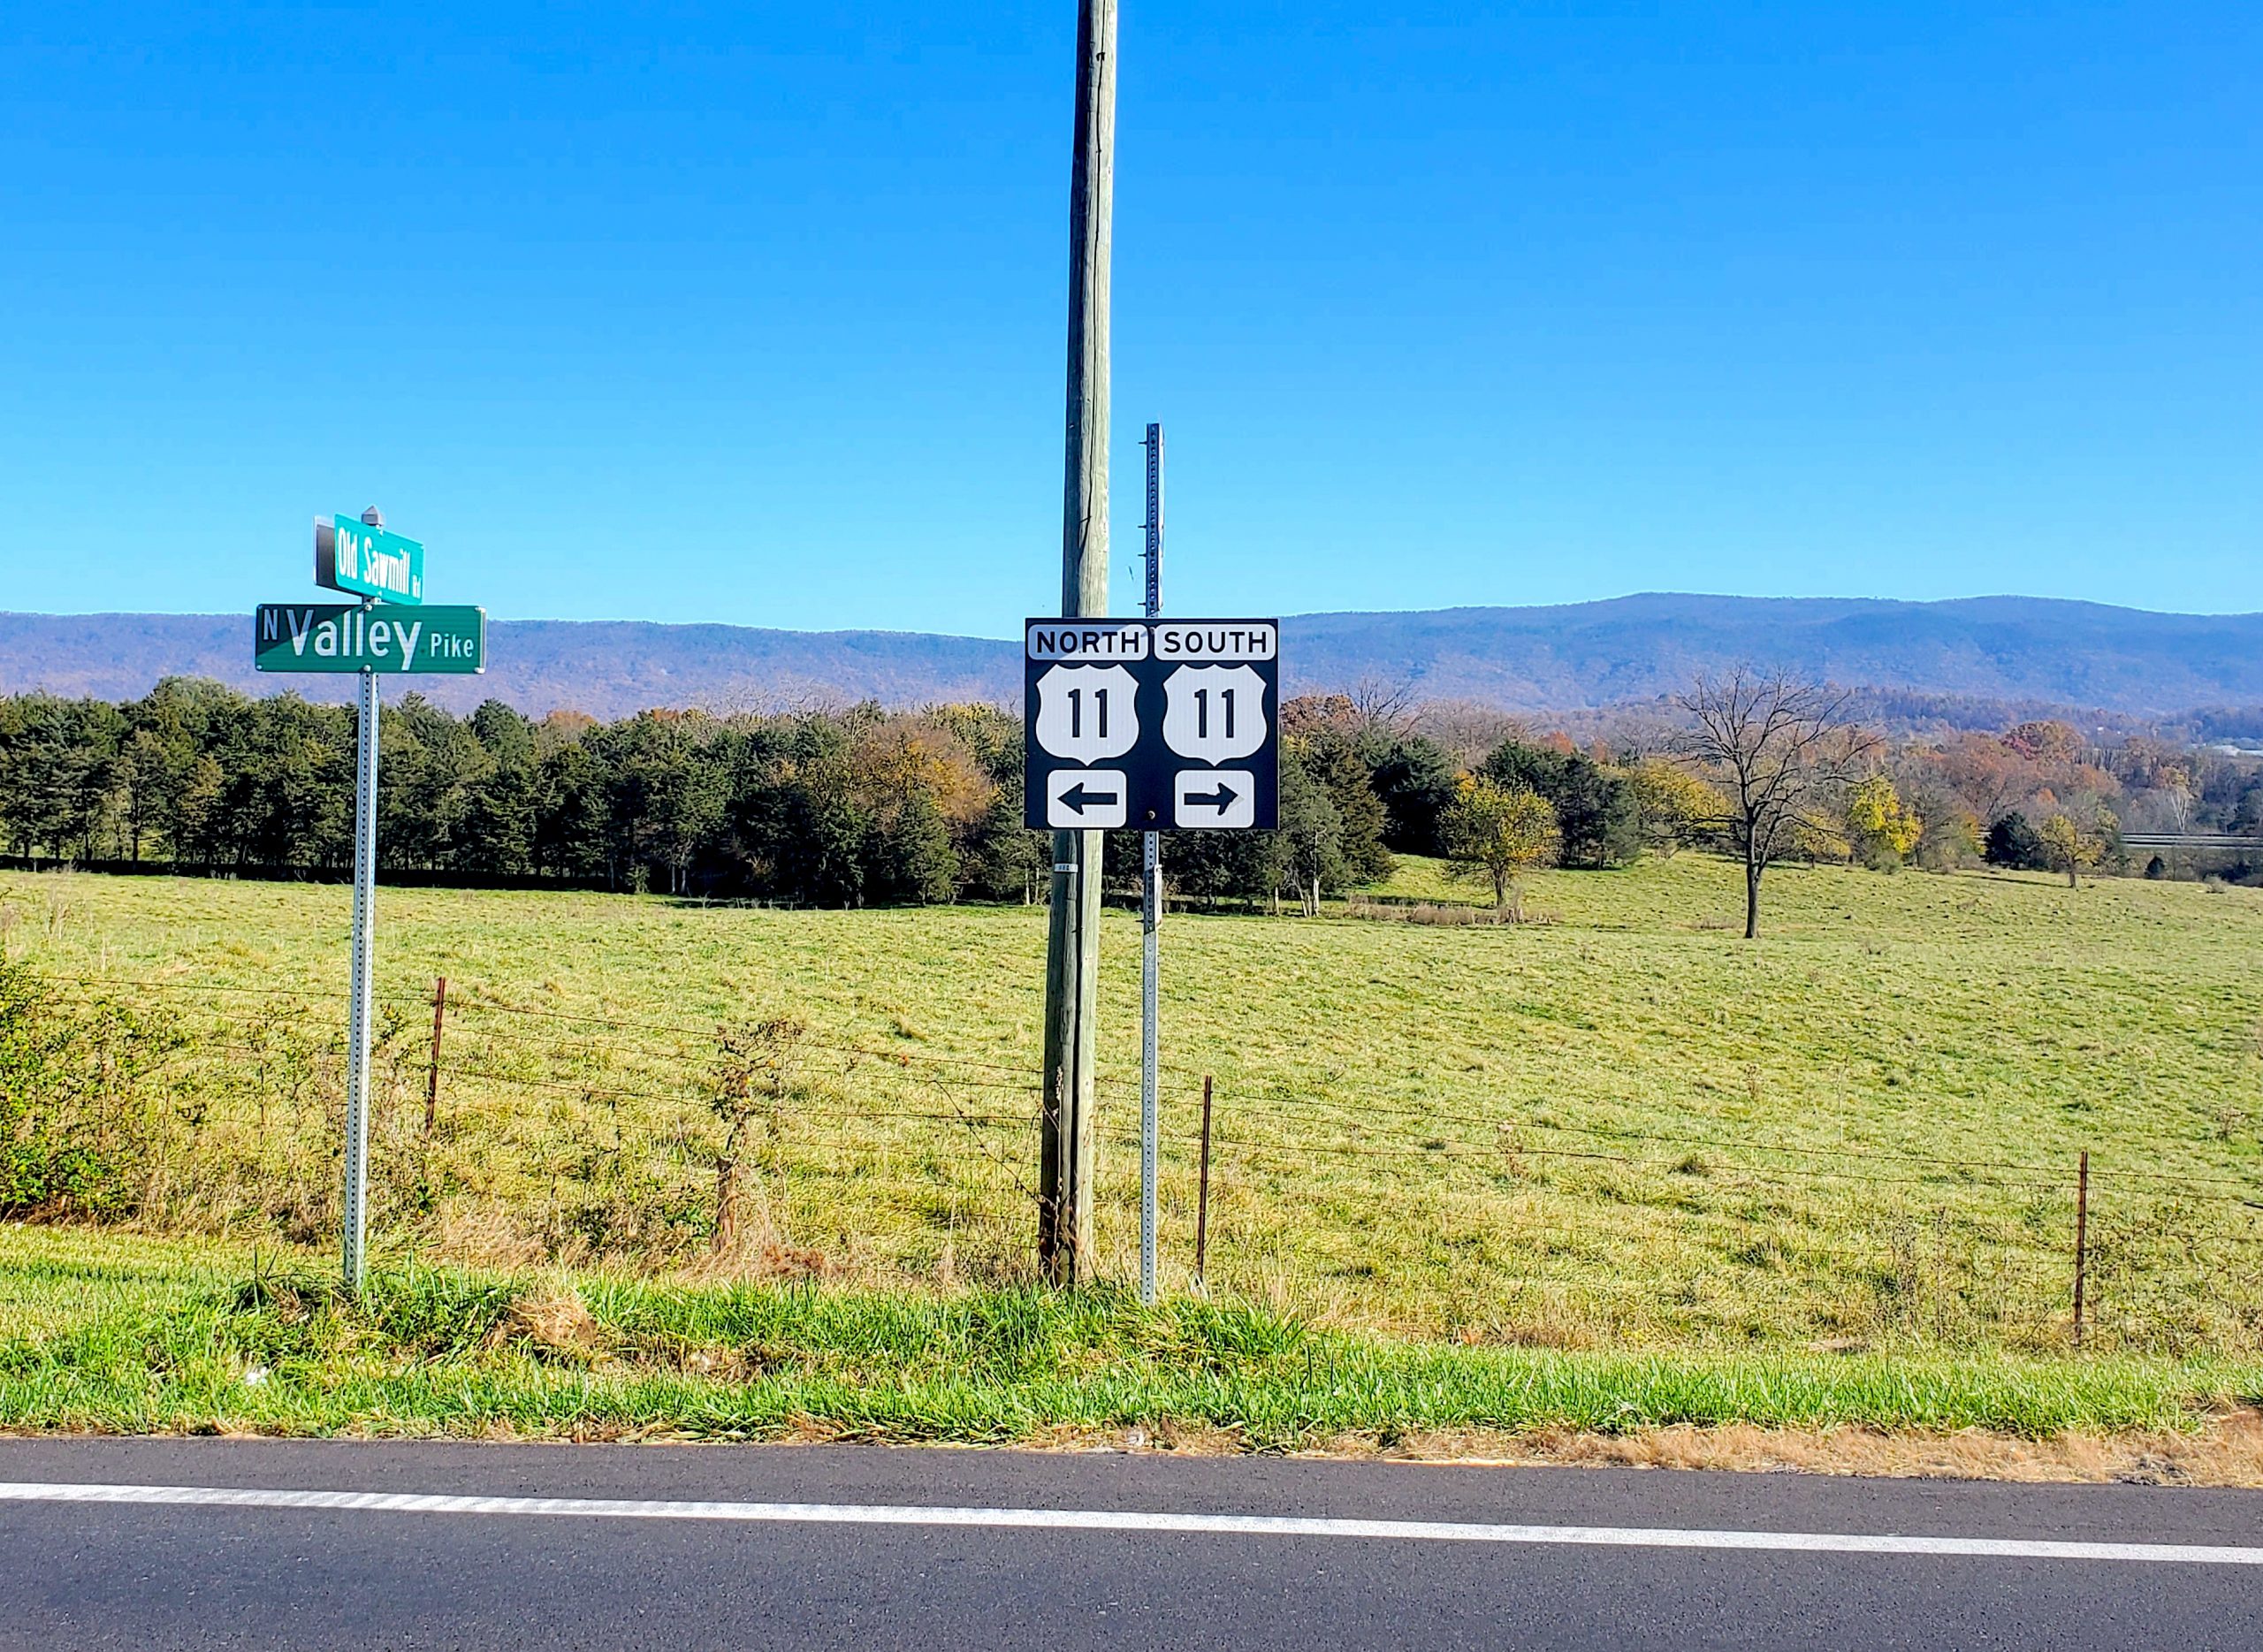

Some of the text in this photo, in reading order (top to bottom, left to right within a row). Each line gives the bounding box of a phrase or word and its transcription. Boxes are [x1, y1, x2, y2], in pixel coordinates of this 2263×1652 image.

[338, 527, 422, 598] Old Sawmill Rd
[263, 609, 474, 671] N Valley Pike
[1036, 631, 1139, 653] NORTH
[1163, 631, 1267, 653] SOUTH
[1068, 689, 1108, 737] 11
[1194, 689, 1234, 738] 11
